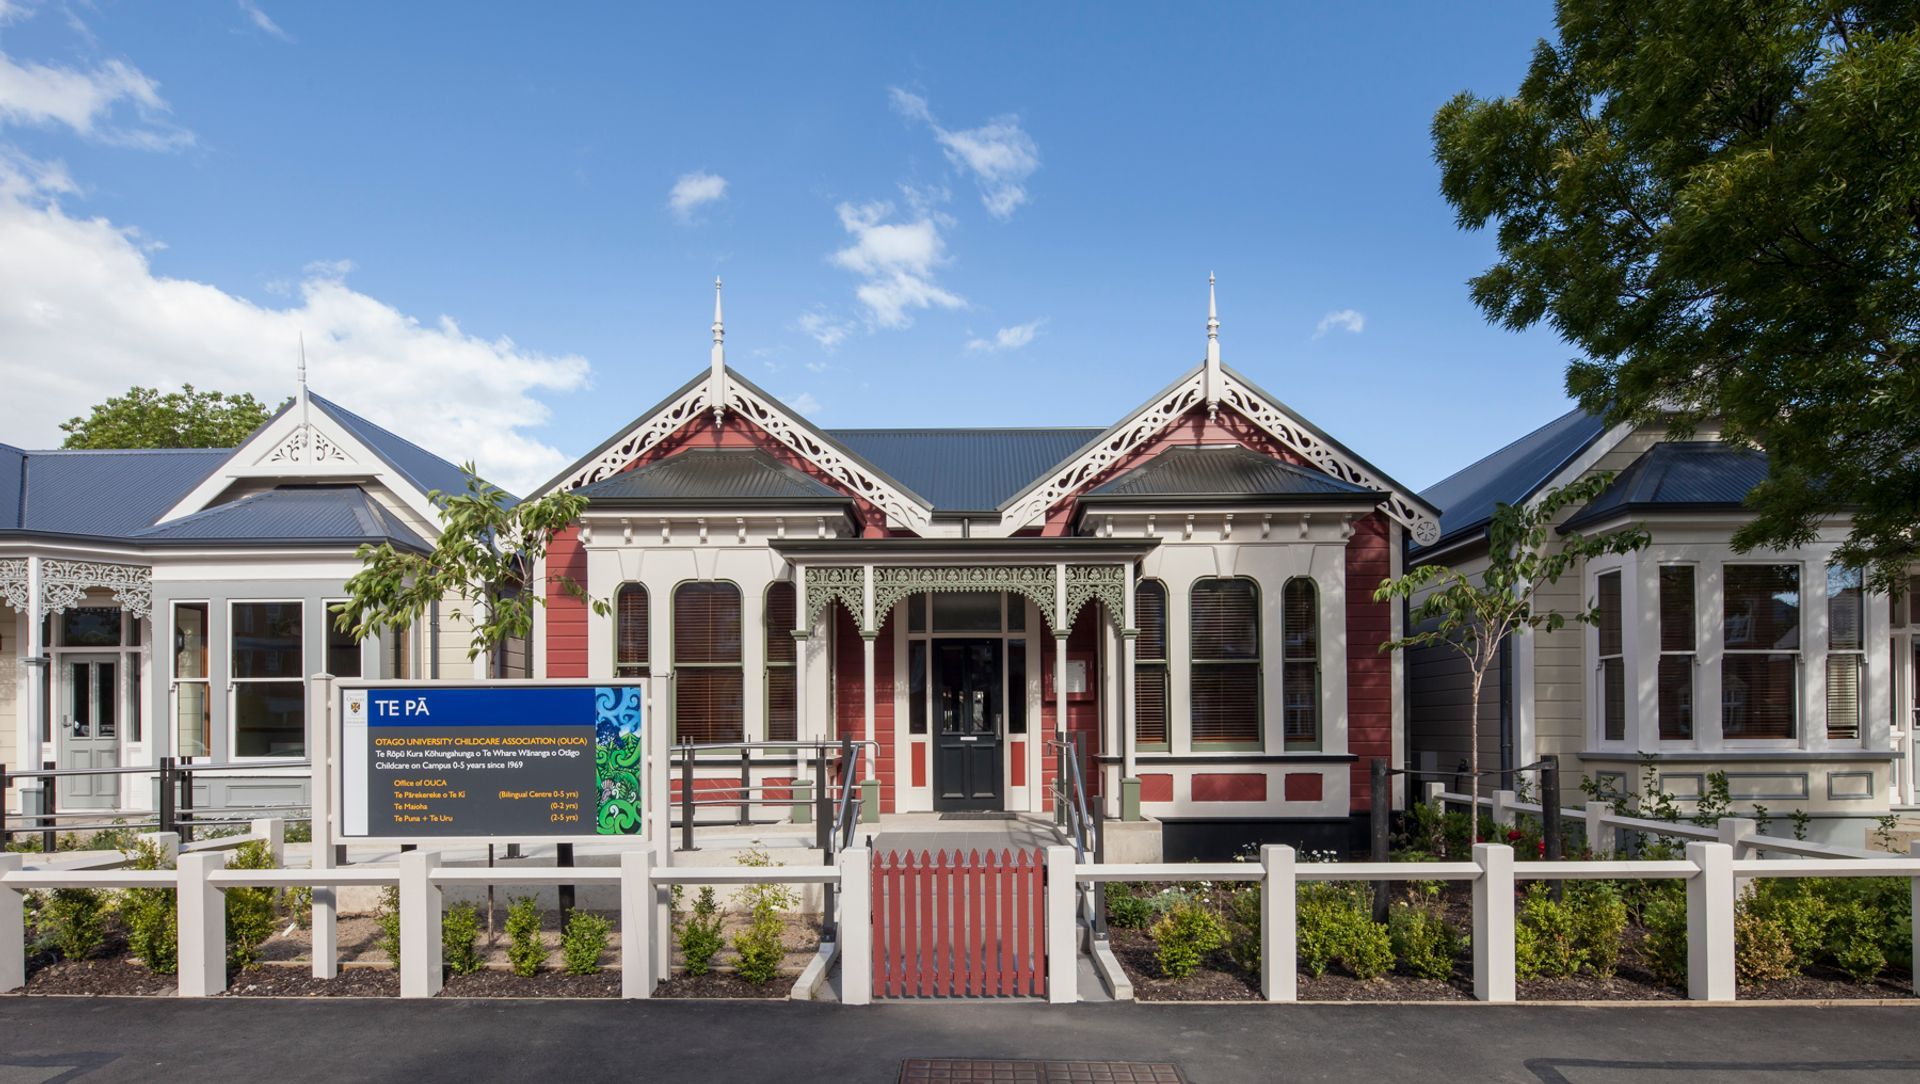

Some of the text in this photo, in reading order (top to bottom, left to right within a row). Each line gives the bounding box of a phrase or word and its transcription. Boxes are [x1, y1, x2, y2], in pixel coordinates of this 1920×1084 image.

[375, 698, 430, 716] TE PĀ
[375, 738, 587, 746] OTAGO UNIVERSITY CHILDCARE ASSOCIATION (OUCA)
[482, 749, 491, 757] Te
[492, 749, 516, 757] Whare
[375, 761, 410, 770] Childcare
[422, 761, 451, 771] Campus
[452, 761, 464, 770] 0-5
[466, 762, 486, 771] years
[487, 761, 504, 769] since
[507, 760, 523, 769] 1969
[394, 779, 447, 787] Office of OUCA
[498, 790, 528, 800] (Bilingual
[566, 790, 579, 800] yrs)
[550, 802, 579, 810] (0-2 yrs)
[394, 814, 402, 822] Te
[404, 814, 420, 822] Puna
[430, 814, 438, 822] Te
[439, 814, 454, 822] Uru
[550, 814, 579, 822] (2-5 yrs)
